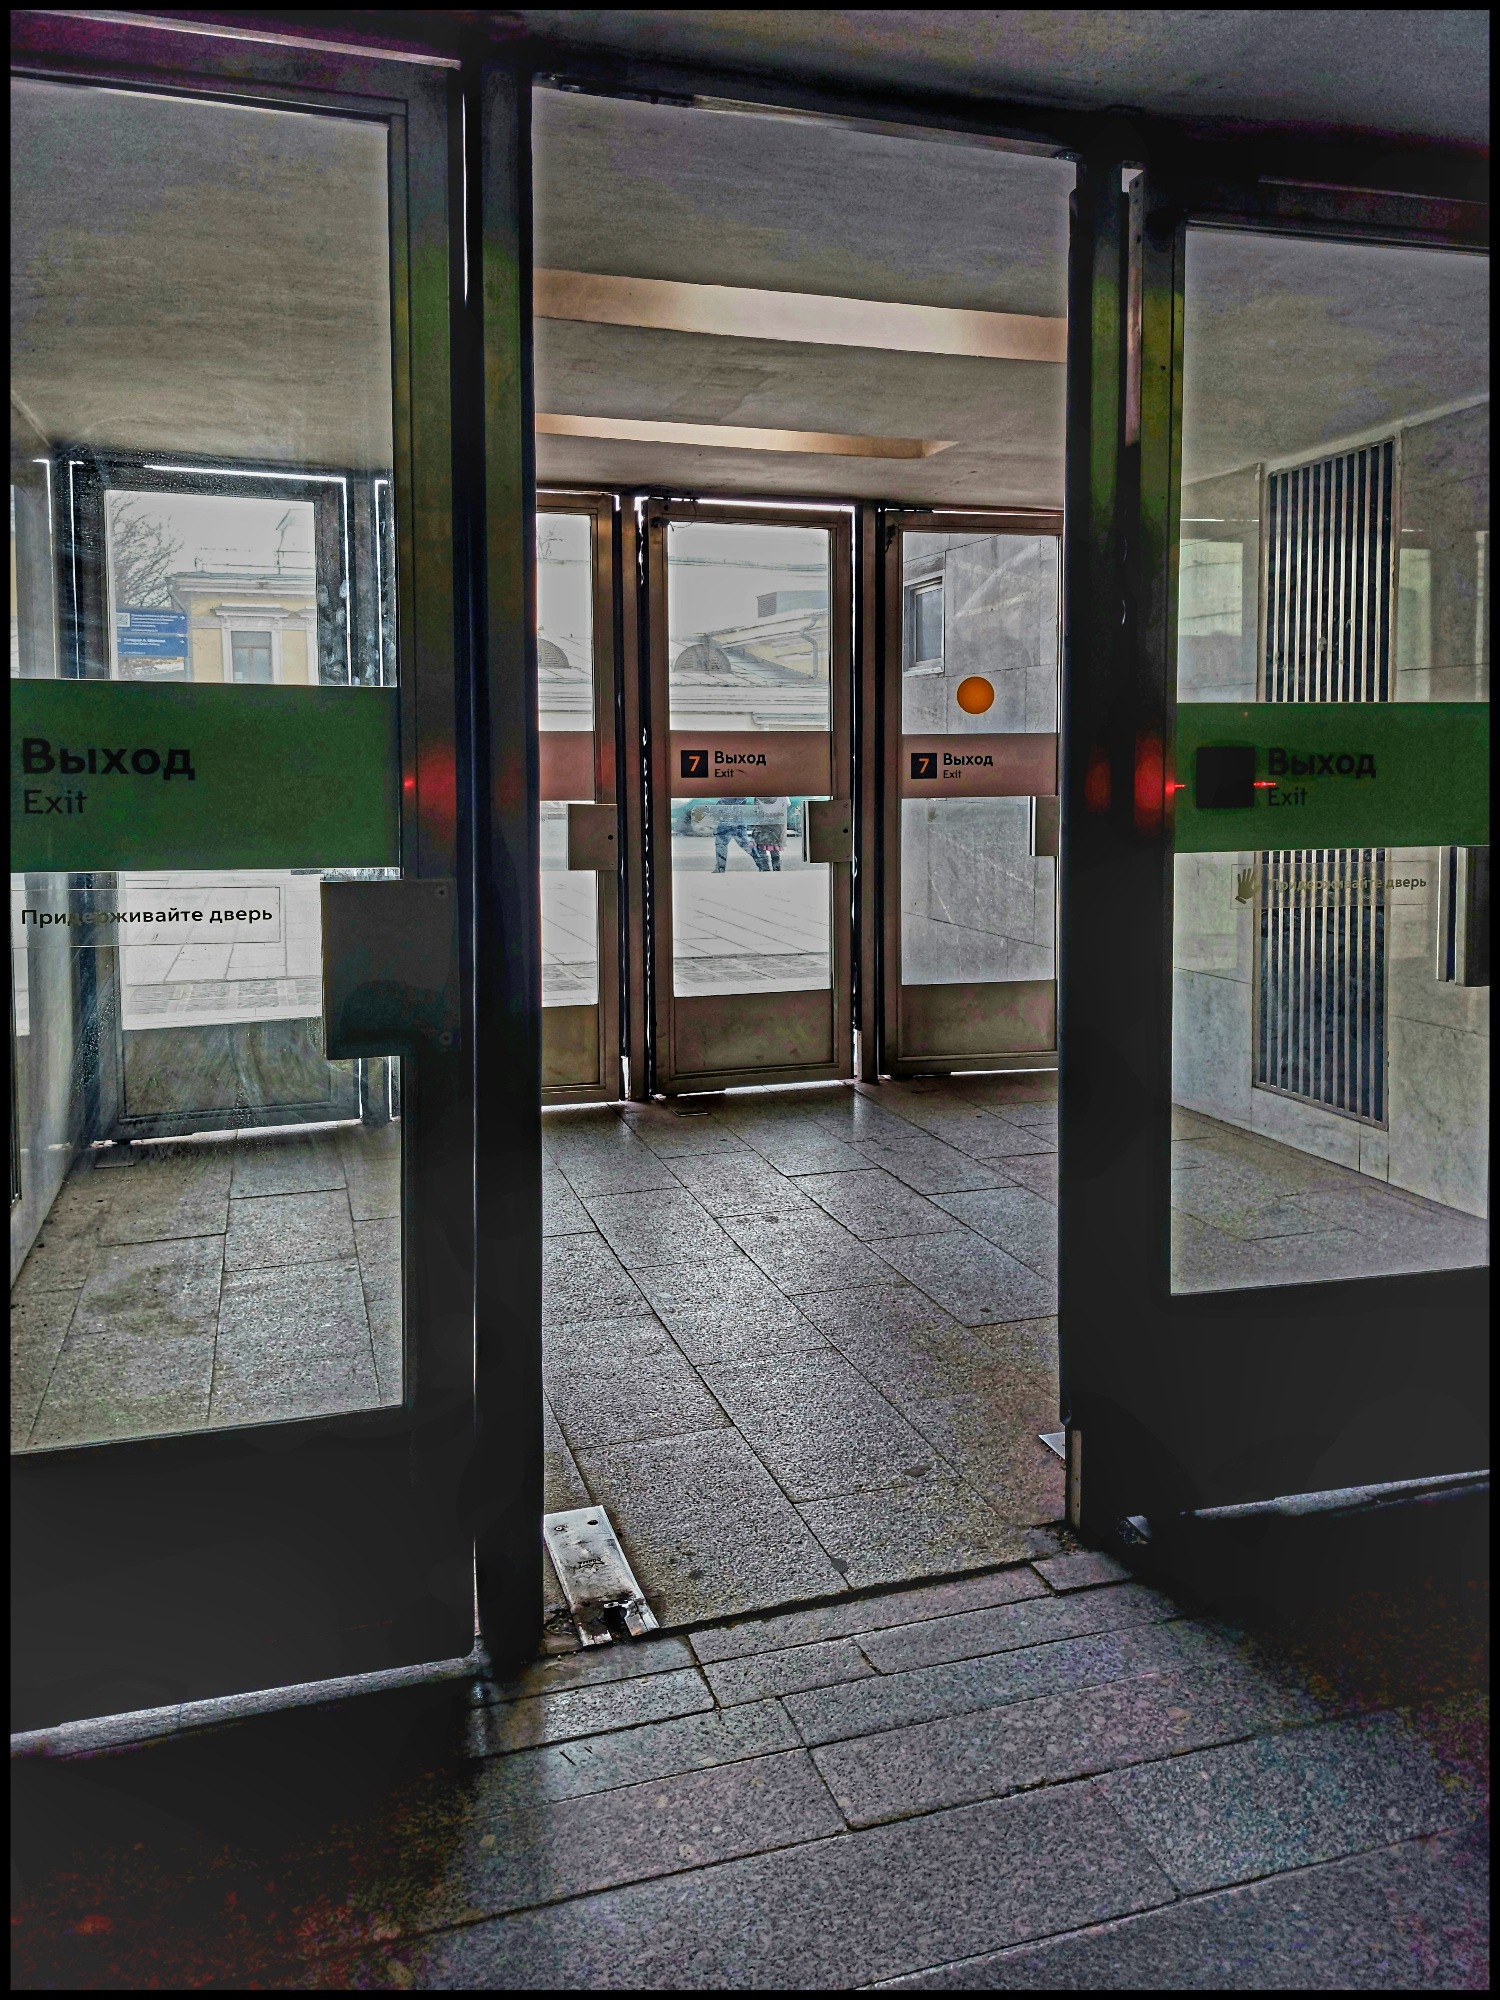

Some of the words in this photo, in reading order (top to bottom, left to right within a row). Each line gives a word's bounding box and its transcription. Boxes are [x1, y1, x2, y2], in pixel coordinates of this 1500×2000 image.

[22, 738, 195, 781] Выход
[688, 755, 701, 772] 7
[714, 750, 767, 766] Выход
[918, 757, 930, 774] 7
[943, 752, 994, 767] Выход
[1268, 748, 1377, 778] Выход
[714, 768, 735, 778] Exit
[943, 769, 962, 779] Exit
[23, 789, 88, 815] Exit
[1268, 786, 1309, 807] Exit
[1385, 877, 1427, 891] дверь
[21, 907, 204, 929] Придерживайте
[209, 908, 273, 925] дверь
